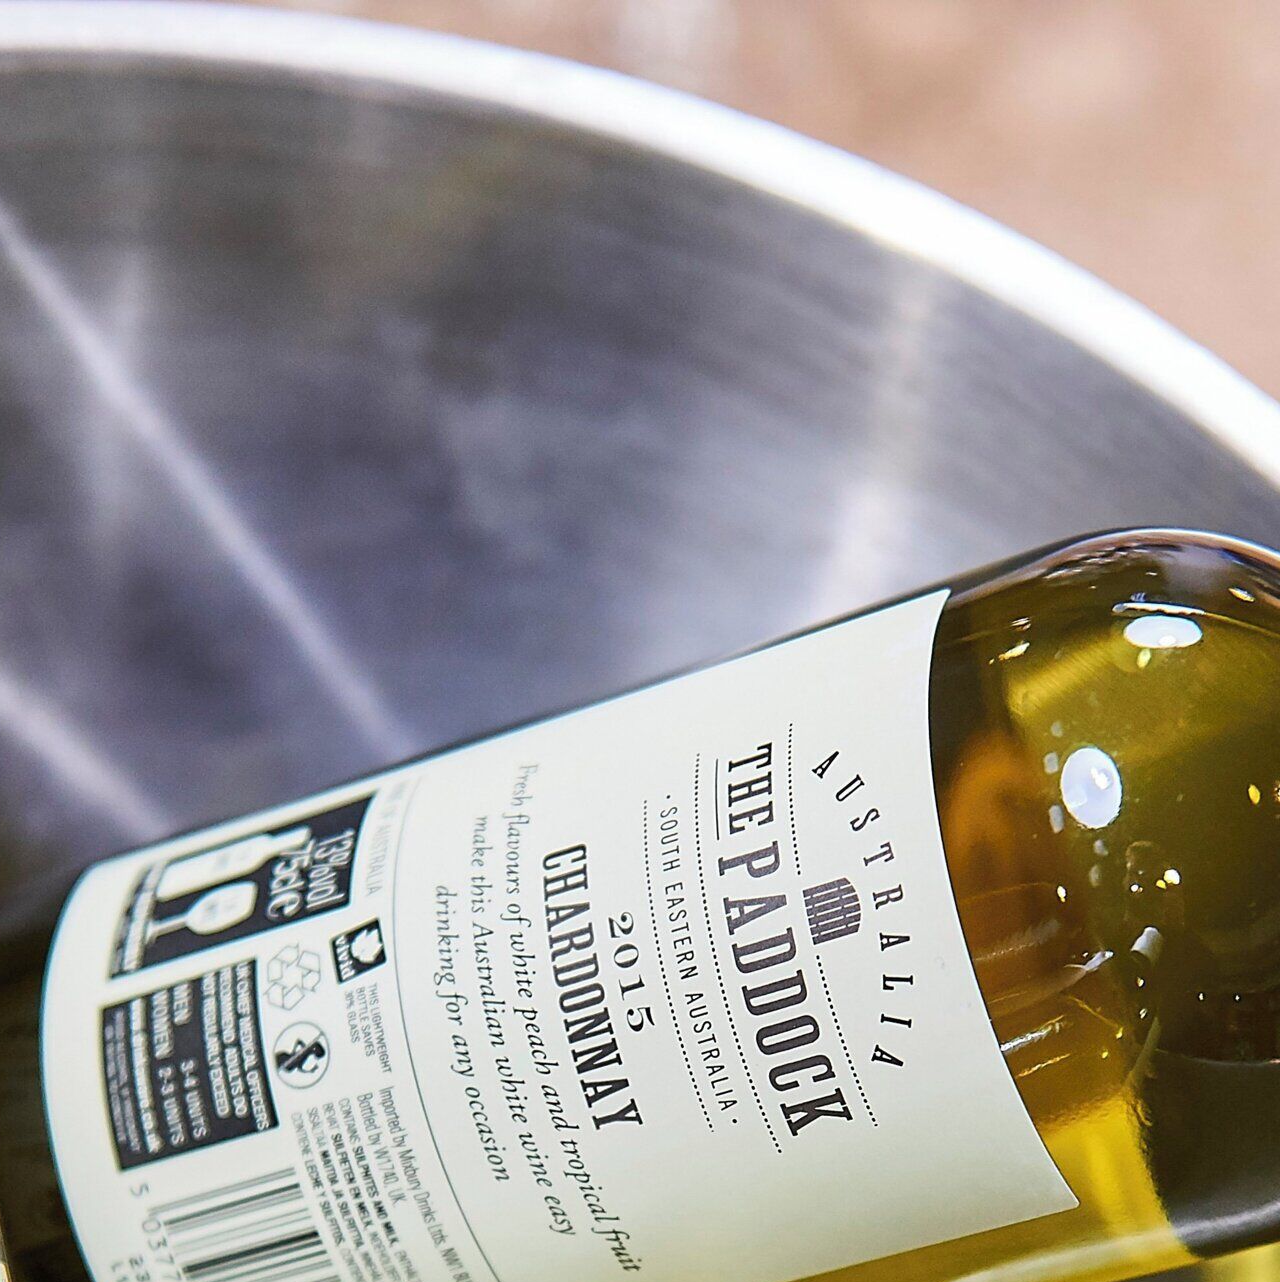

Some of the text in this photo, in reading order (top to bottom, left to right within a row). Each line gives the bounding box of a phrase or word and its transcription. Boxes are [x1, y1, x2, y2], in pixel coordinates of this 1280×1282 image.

[714, 741, 853, 1137] THE PADDOCK
[811, 749, 915, 1067] AUSTRALIA
[333, 935, 356, 980] vivid
[540, 841, 643, 1132] CHARDONNAY
[605, 910, 654, 1034] 2015
[658, 805, 738, 1112] SOUTH EASTERN AUSTRALIA
[234, 978, 250, 1016] CHIEF
[346, 1010, 360, 1044] GLASS
[355, 986, 375, 1057] BOTTLE SAVES
[367, 982, 392, 1074] THIS LIGHTWEIGHT
[469, 814, 576, 1236] make this Australian white wine easy
[500, 762, 642, 1274] Fresh flavours of white peach and tropical fruit
[171, 982, 207, 1138] MEN 3-4 UNITS
[237, 1015, 256, 1071] MEDICAL
[431, 881, 511, 1182] drinking for any occasion
[149, 988, 184, 1145] WOMEN 2-3 UNITS
[208, 1067, 229, 1117] EXCEED
[223, 1045, 244, 1097] ADULTS
[231, 1095, 247, 1116] DO
[244, 1069, 270, 1131] OFFICERS
[355, 1091, 380, 1132] Bottled
[377, 1085, 405, 1134] Imported
[367, 1132, 381, 1146] by
[390, 1133, 407, 1148] by
[397, 1148, 422, 1191] Mixbury
[350, 1144, 379, 1199] SULPHITES
[372, 1199, 388, 1220] AND
[411, 1190, 439, 1228] Drinks
